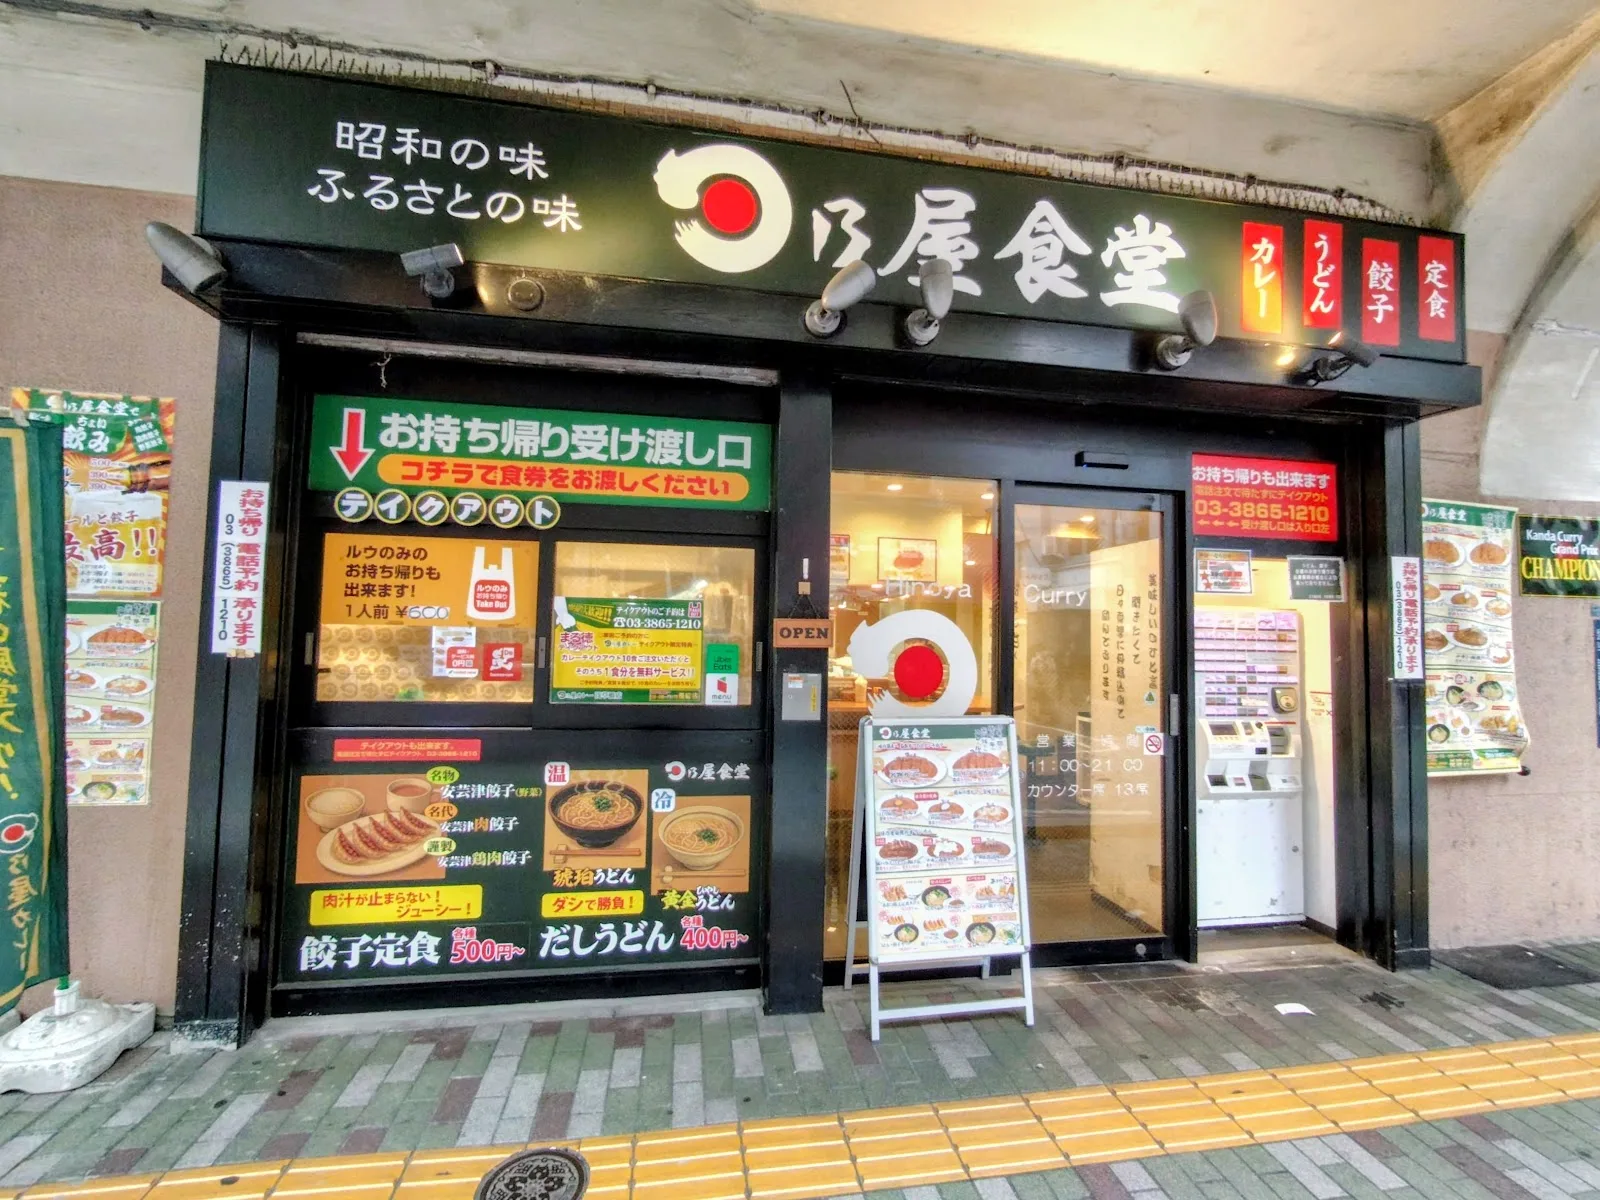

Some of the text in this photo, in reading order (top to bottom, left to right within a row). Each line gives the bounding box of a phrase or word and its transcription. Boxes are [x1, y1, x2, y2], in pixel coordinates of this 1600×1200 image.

[336, 121, 549, 181] 昭和の味
[307, 168, 582, 233] ふるさとの味
[1250, 237, 1275, 318] カレー
[1310, 233, 1336, 313] うどん
[1366, 260, 1395, 324] 餃子
[1423, 260, 1448, 318] 定食
[64, 424, 110, 453] 飲み
[380, 412, 752, 469] お持ち帰り受け渡し口
[401, 459, 730, 497] コチラで食券をお渡しください
[1192, 466, 1331, 490] お持ち帰りも出来ます
[337, 492, 557, 528] テイクアウト
[1194, 499, 1330, 522] 03-3865-1210
[1526, 529, 1583, 545] Kanda Curry
[346, 545, 428, 561] ルウのみの
[1550, 543, 1599, 555] Grand Prix
[345, 564, 441, 580] お持ち帰りも
[344, 582, 416, 598] 出来ます!
[886, 577, 1087, 606] Hinoya Curry
[345, 604, 389, 619] 1人前
[626, 618, 701, 629] 03-3865-1210
[560, 632, 594, 643] まる徳
[779, 627, 829, 639] OPEN
[430, 769, 455, 781] 名物
[547, 765, 567, 783] 温
[1028, 759, 1143, 773] 11:00~2100
[1027, 782, 1105, 797] カウンター席
[654, 791, 672, 809] 冷
[429, 805, 454, 817] 名代
[440, 816, 519, 833] 安芸津肉餃子
[426, 840, 453, 853] 謹製
[437, 850, 532, 868] 安芸津鶏肉餃子
[552, 868, 635, 887] 琥珀うどん
[322, 890, 441, 908] 肉汁が止まらない!
[552, 896, 634, 912] ダシで勝負!
[661, 889, 736, 911] 黄金うどん
[396, 903, 472, 919] ジューシー!
[681, 915, 703, 928] 各種
[452, 927, 476, 940] 各種
[538, 919, 675, 958] だしうどん
[300, 930, 442, 972] 餃子定食
